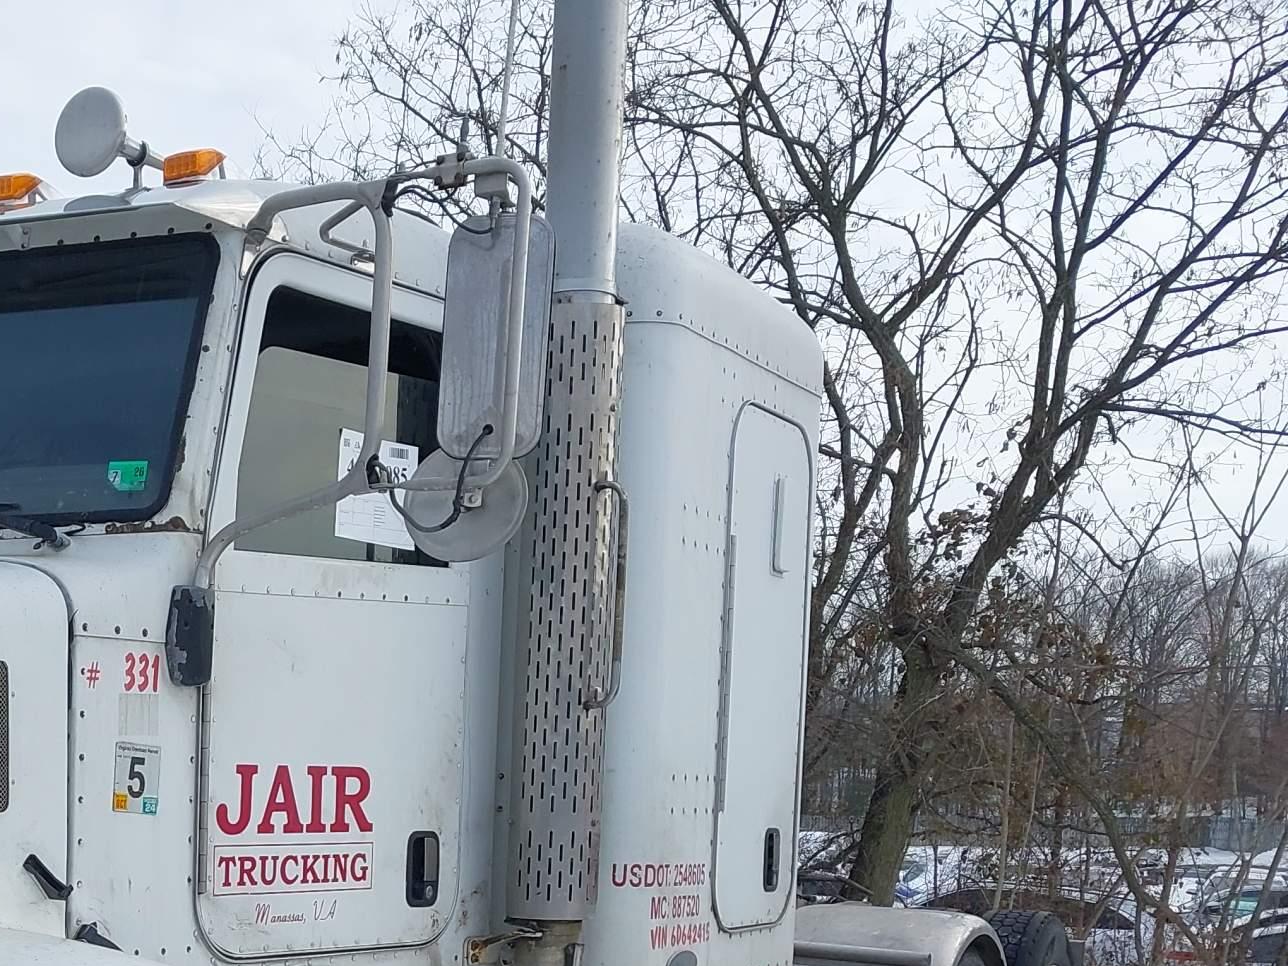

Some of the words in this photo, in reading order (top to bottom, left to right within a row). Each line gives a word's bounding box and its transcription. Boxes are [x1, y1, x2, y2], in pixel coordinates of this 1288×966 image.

[86, 661, 100, 688] #
[124, 652, 160, 693] 331
[127, 756, 145, 798] 5
[216, 764, 373, 835] JAIR
[218, 853, 368, 887] TRUCKING
[612, 863, 671, 887] USDOT:
[673, 863, 705, 886] 2548605
[255, 903, 306, 925] Manassas,
[313, 899, 336, 920] VA
[650, 896, 670, 919] MC:
[672, 894, 700, 918] 887520
[650, 925, 667, 950] VIN
